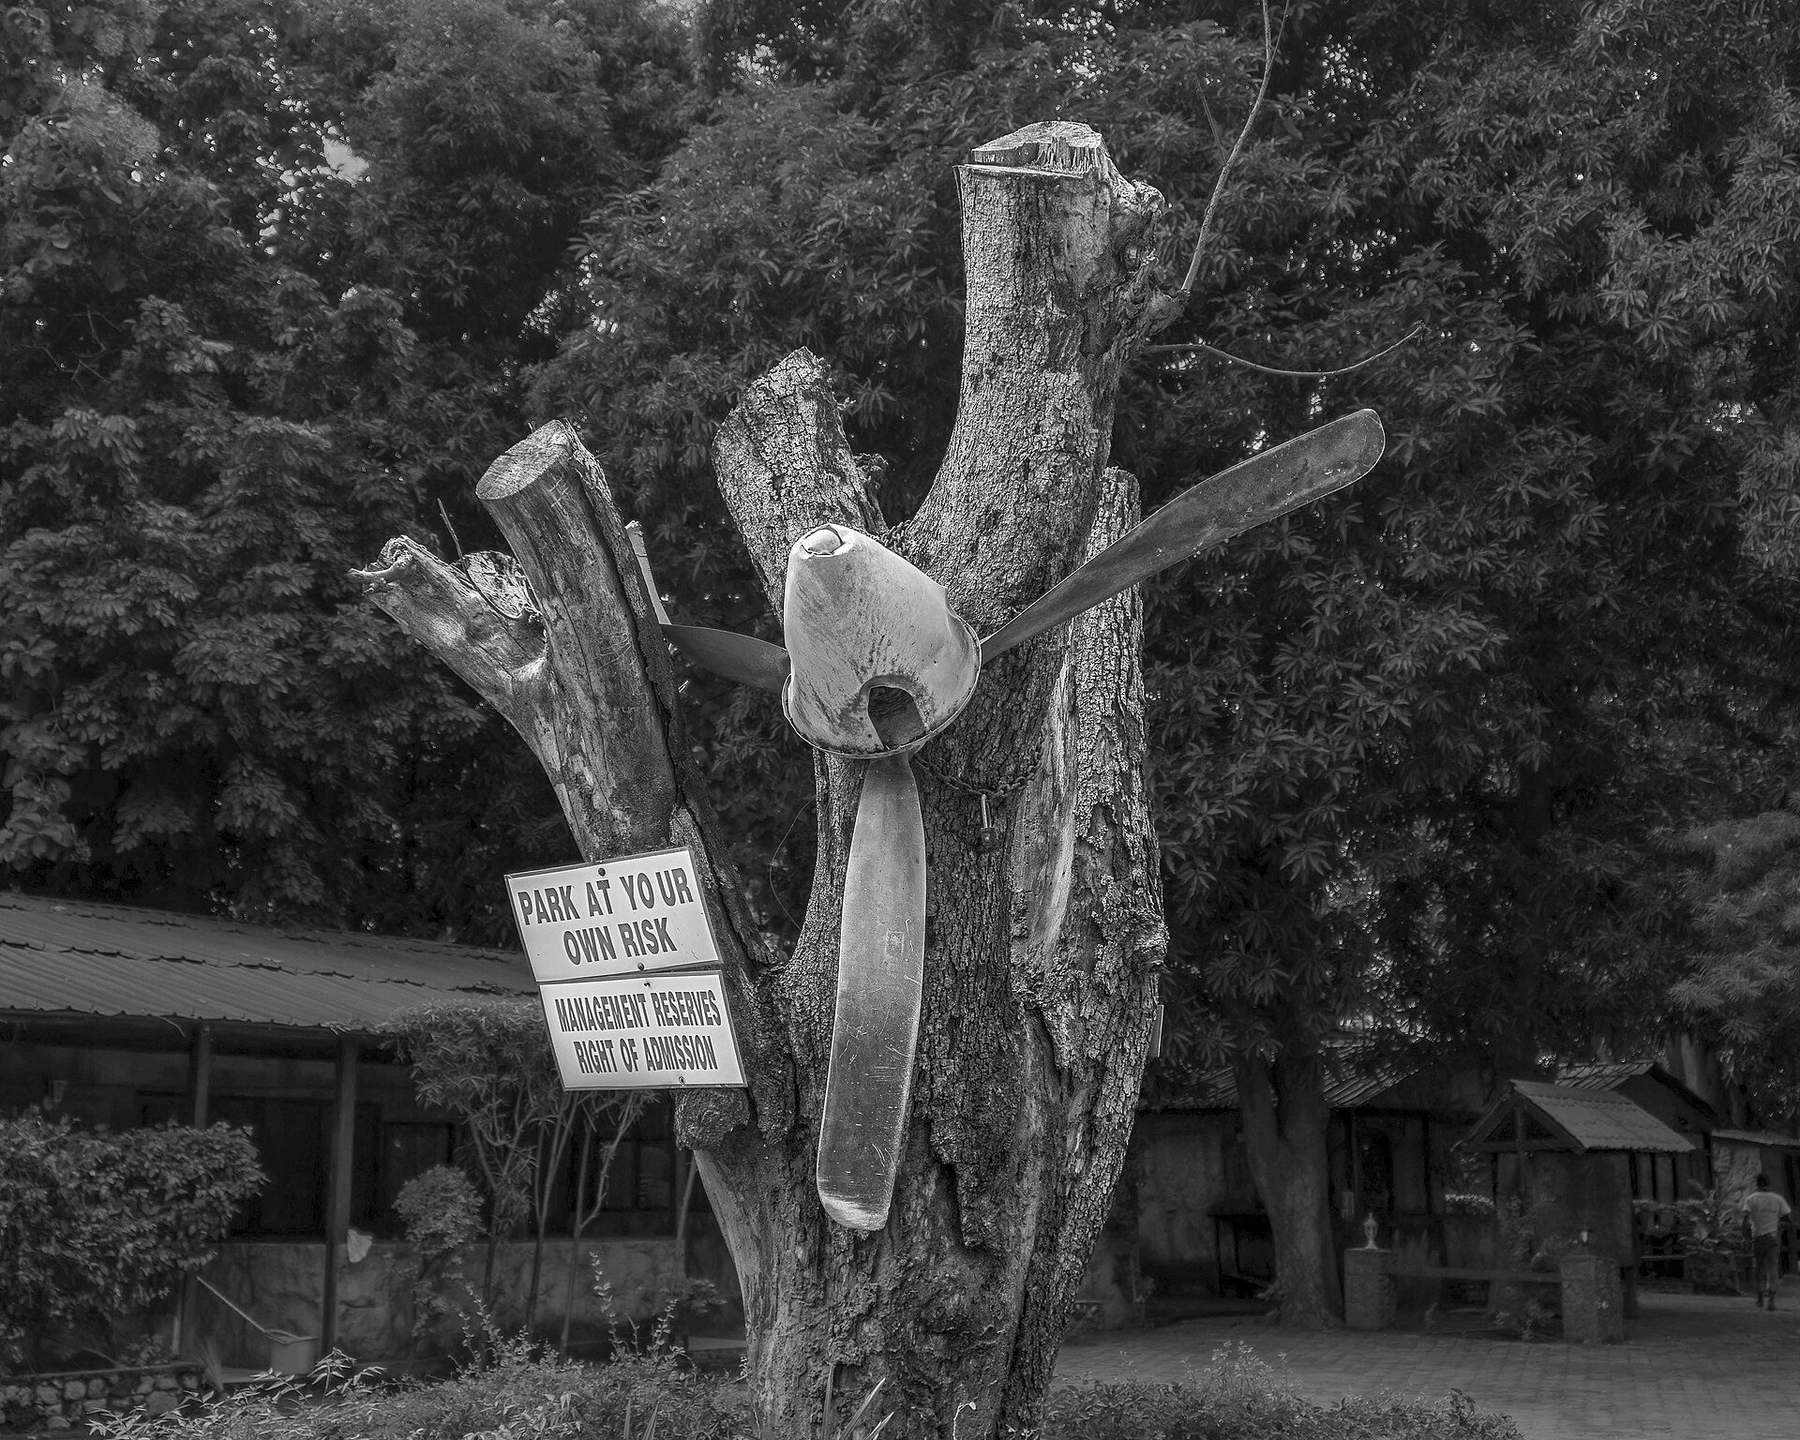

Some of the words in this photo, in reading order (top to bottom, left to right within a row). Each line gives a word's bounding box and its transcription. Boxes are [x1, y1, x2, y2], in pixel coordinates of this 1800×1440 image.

[517, 885, 581, 926] PARK
[586, 879, 613, 917] AT
[563, 925, 617, 966] OWN
[618, 917, 678, 958] RISK
[554, 993, 651, 1033] MANAGEMENT
[650, 989, 722, 1027] RESERVES
[573, 1039, 618, 1074] RIGHT
[619, 1038, 639, 1073] OF
[642, 1034, 719, 1072] ADMISSION
